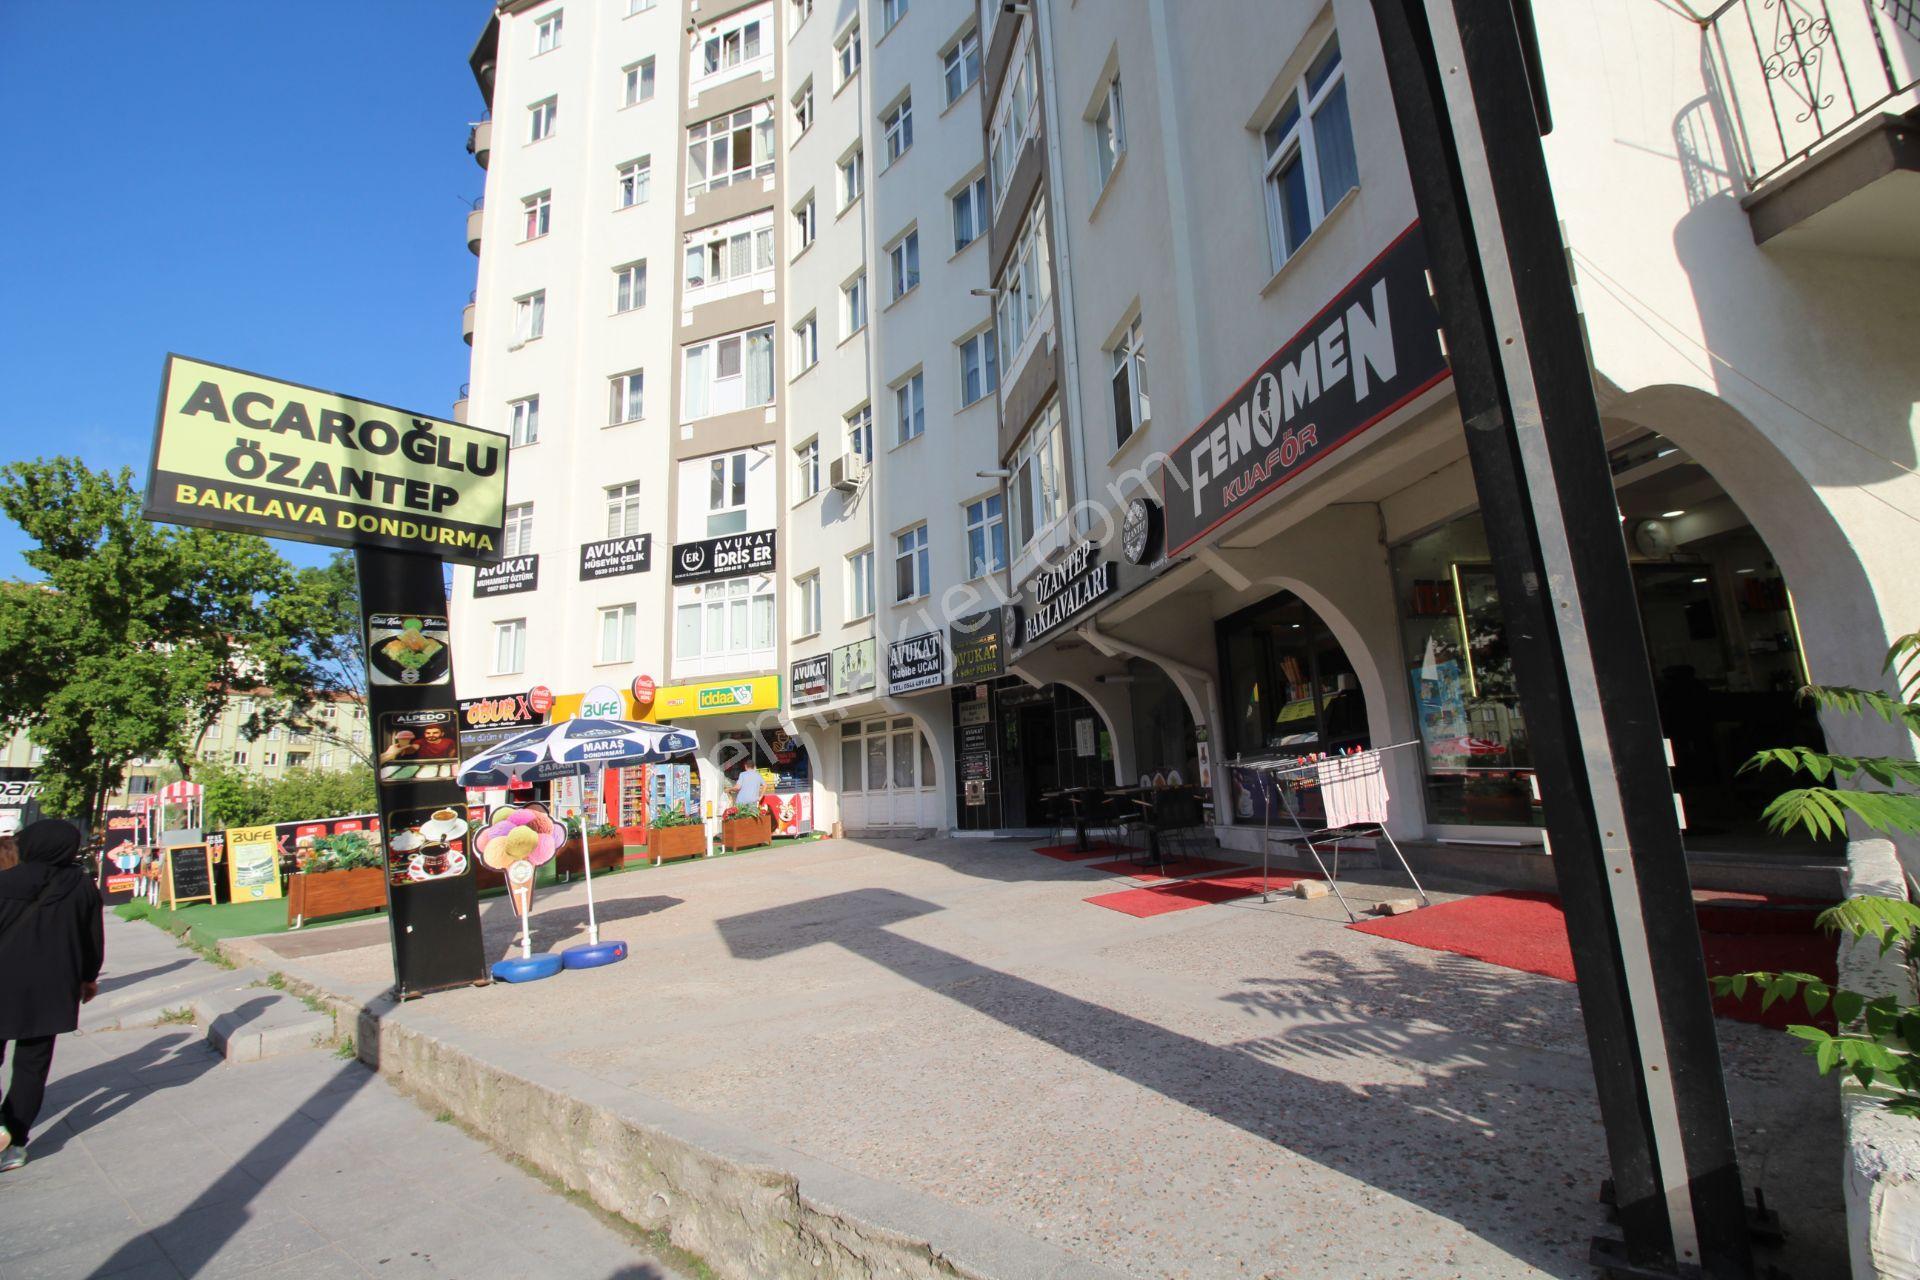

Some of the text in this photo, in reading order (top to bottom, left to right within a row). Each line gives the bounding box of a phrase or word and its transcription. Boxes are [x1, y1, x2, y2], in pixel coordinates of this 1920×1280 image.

[1190, 277, 1398, 519] FENOMEN
[179, 380, 499, 478] ACAROĞLU
[225, 437, 460, 514] ÖZANTEP
[1222, 423, 1319, 508] KUAFÖR
[175, 484, 494, 552] BAKLAVA DONDURMA
[585, 538, 645, 559] AVUKAT
[715, 532, 773, 551] AVUKAT
[478, 557, 534, 578] AVUKAT
[584, 552, 645, 570] HÜSEYİN ÇELİK
[685, 552, 700, 563] ER
[714, 546, 772, 568] İDRİS ER
[510, 572, 534, 582] ÖZTÜRK
[1035, 541, 1091, 605] ÖZANTEP
[1025, 560, 1109, 643] BAKLAVALARI
[889, 636, 939, 667] AVUKAT
[793, 661, 826, 681] AVUKAT
[892, 664, 916, 679] Habibe
[917, 659, 939, 676] UÇAN
[701, 692, 735, 706] iddaa
[396, 713, 446, 722] ALPEDO
[583, 739, 625, 752] MARAŞ
[583, 749, 625, 759] DONDURMASI
